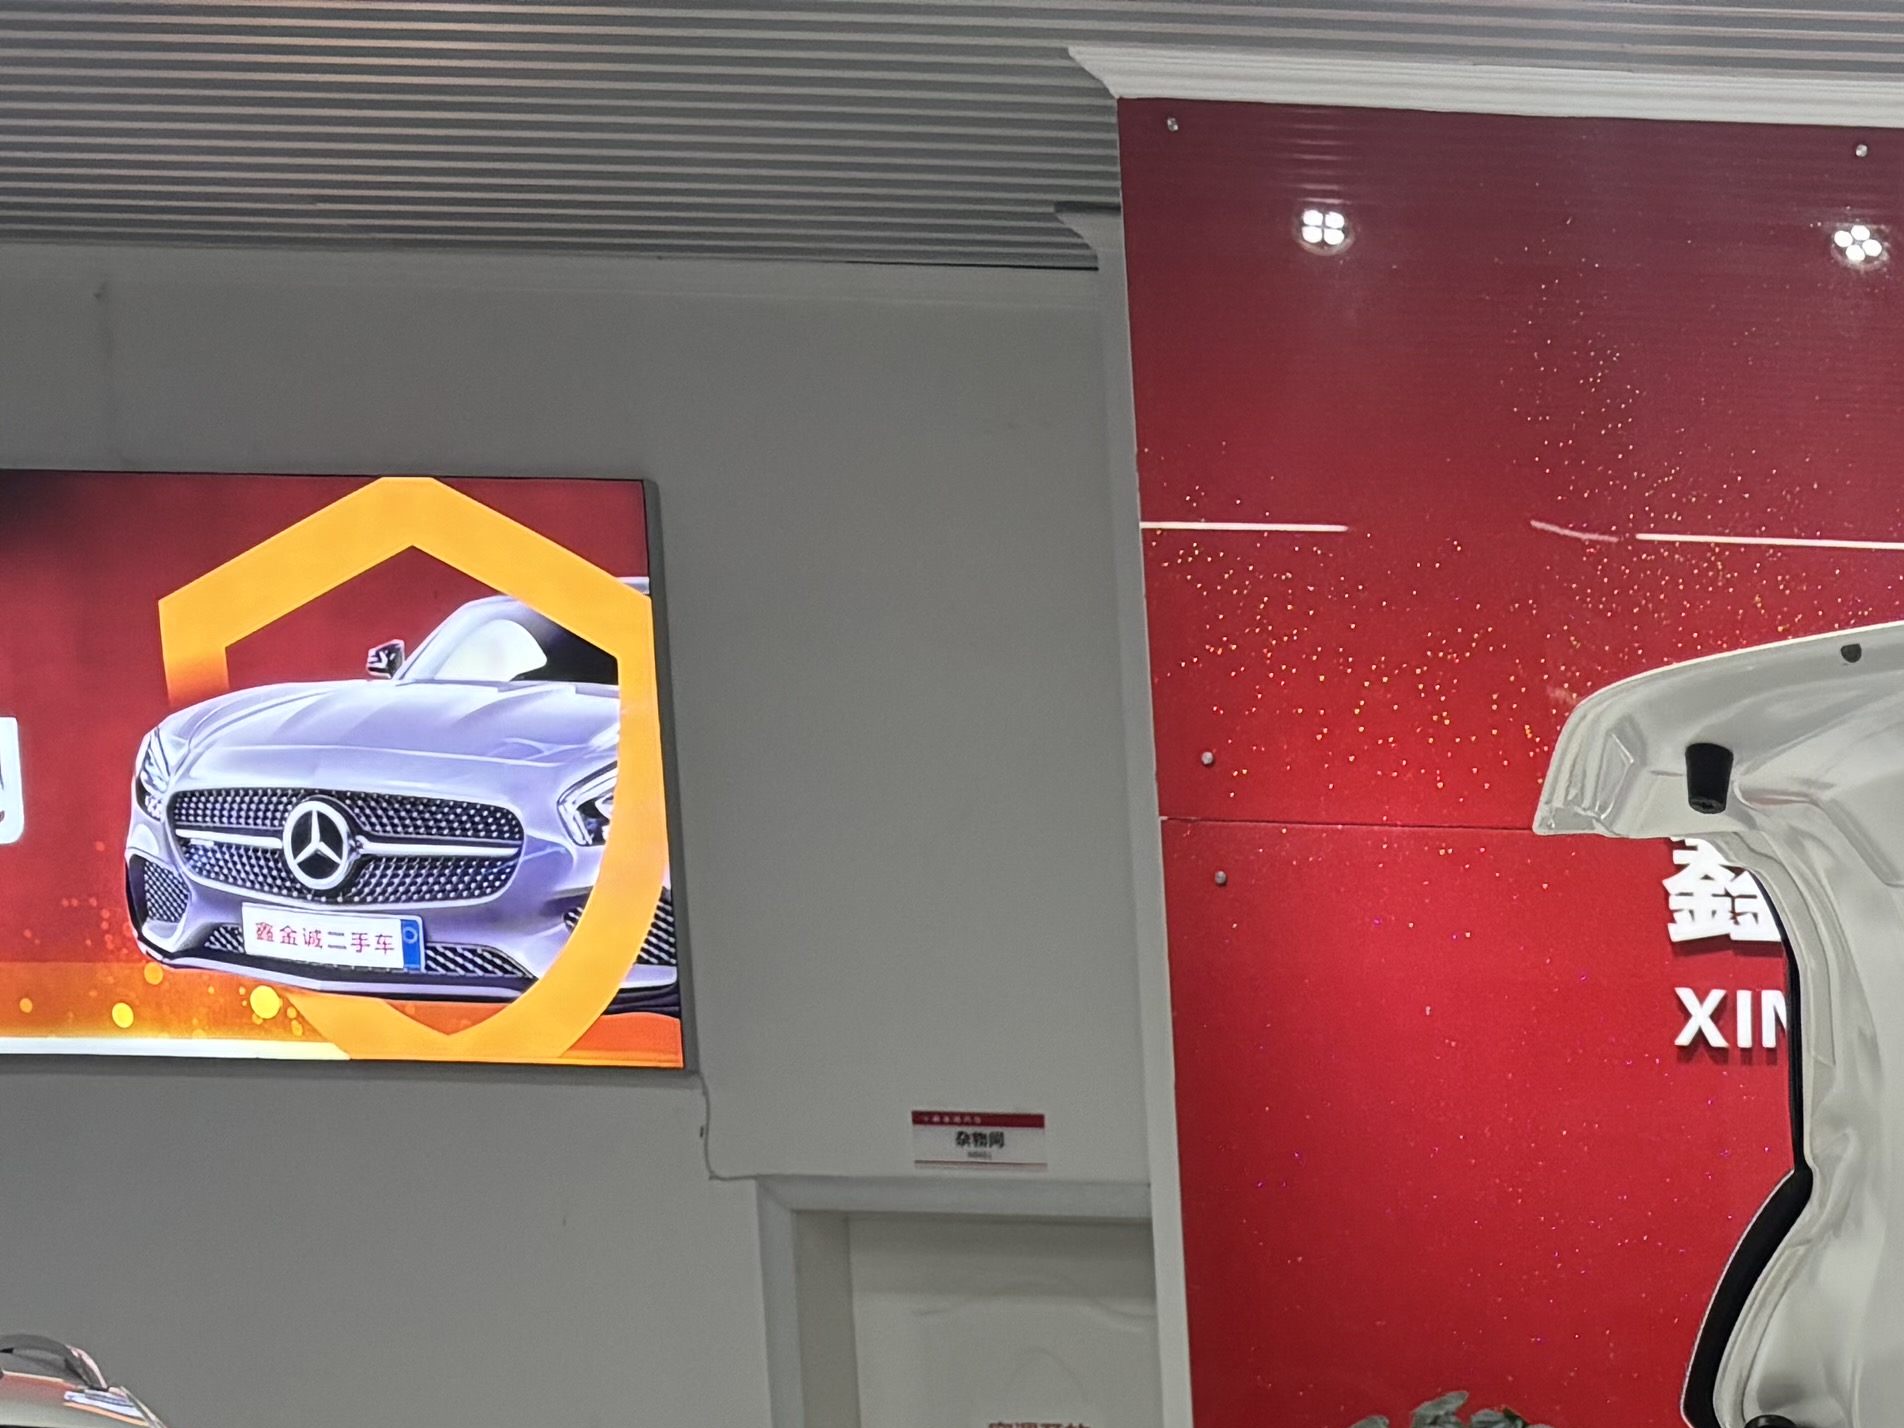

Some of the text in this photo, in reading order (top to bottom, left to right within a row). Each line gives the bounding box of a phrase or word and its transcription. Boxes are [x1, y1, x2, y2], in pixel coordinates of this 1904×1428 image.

[256, 921, 394, 955] 鑫金诚二手车
